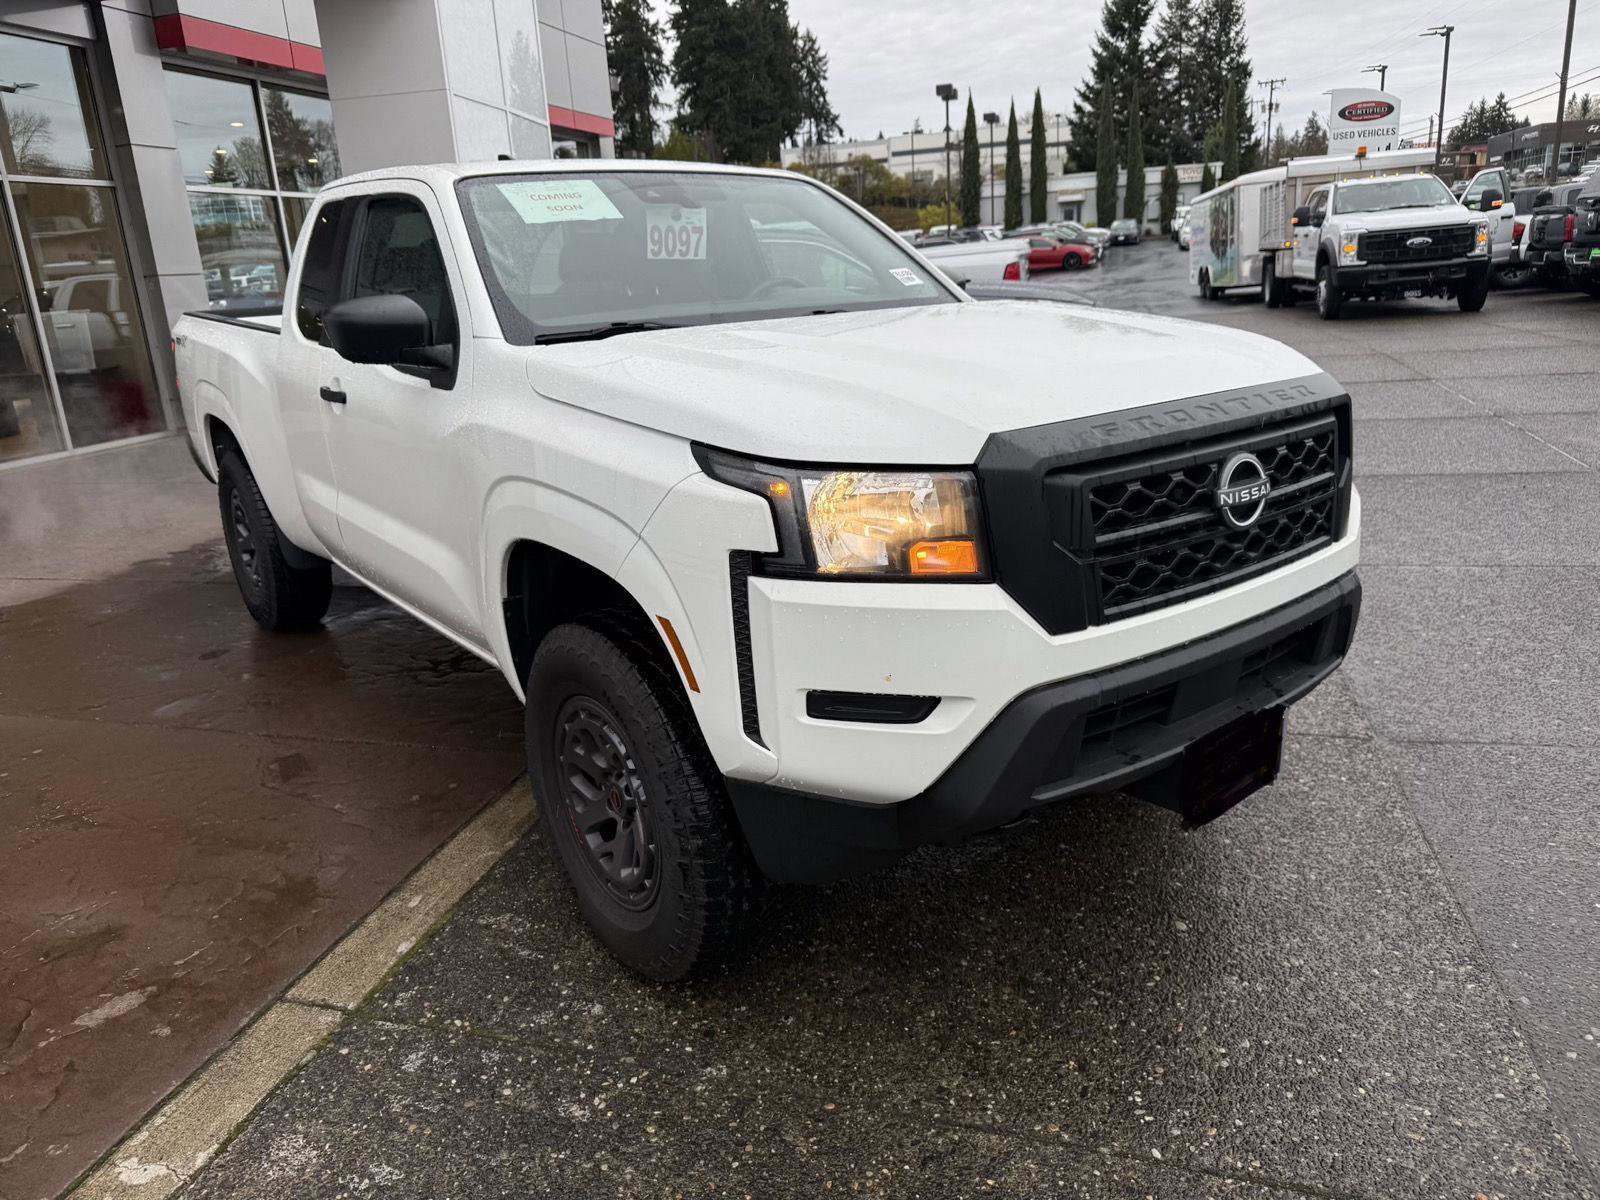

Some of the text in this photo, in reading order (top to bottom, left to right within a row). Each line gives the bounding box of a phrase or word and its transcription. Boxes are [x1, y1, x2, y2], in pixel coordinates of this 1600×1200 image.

[1345, 106, 1388, 117] CERTIFIED
[1333, 127, 1397, 141] USED VEHICLES
[530, 192, 583, 202] COMING
[546, 204, 584, 213] SOON
[650, 224, 704, 258] 9097
[1090, 384, 1317, 441] FRONTIER
